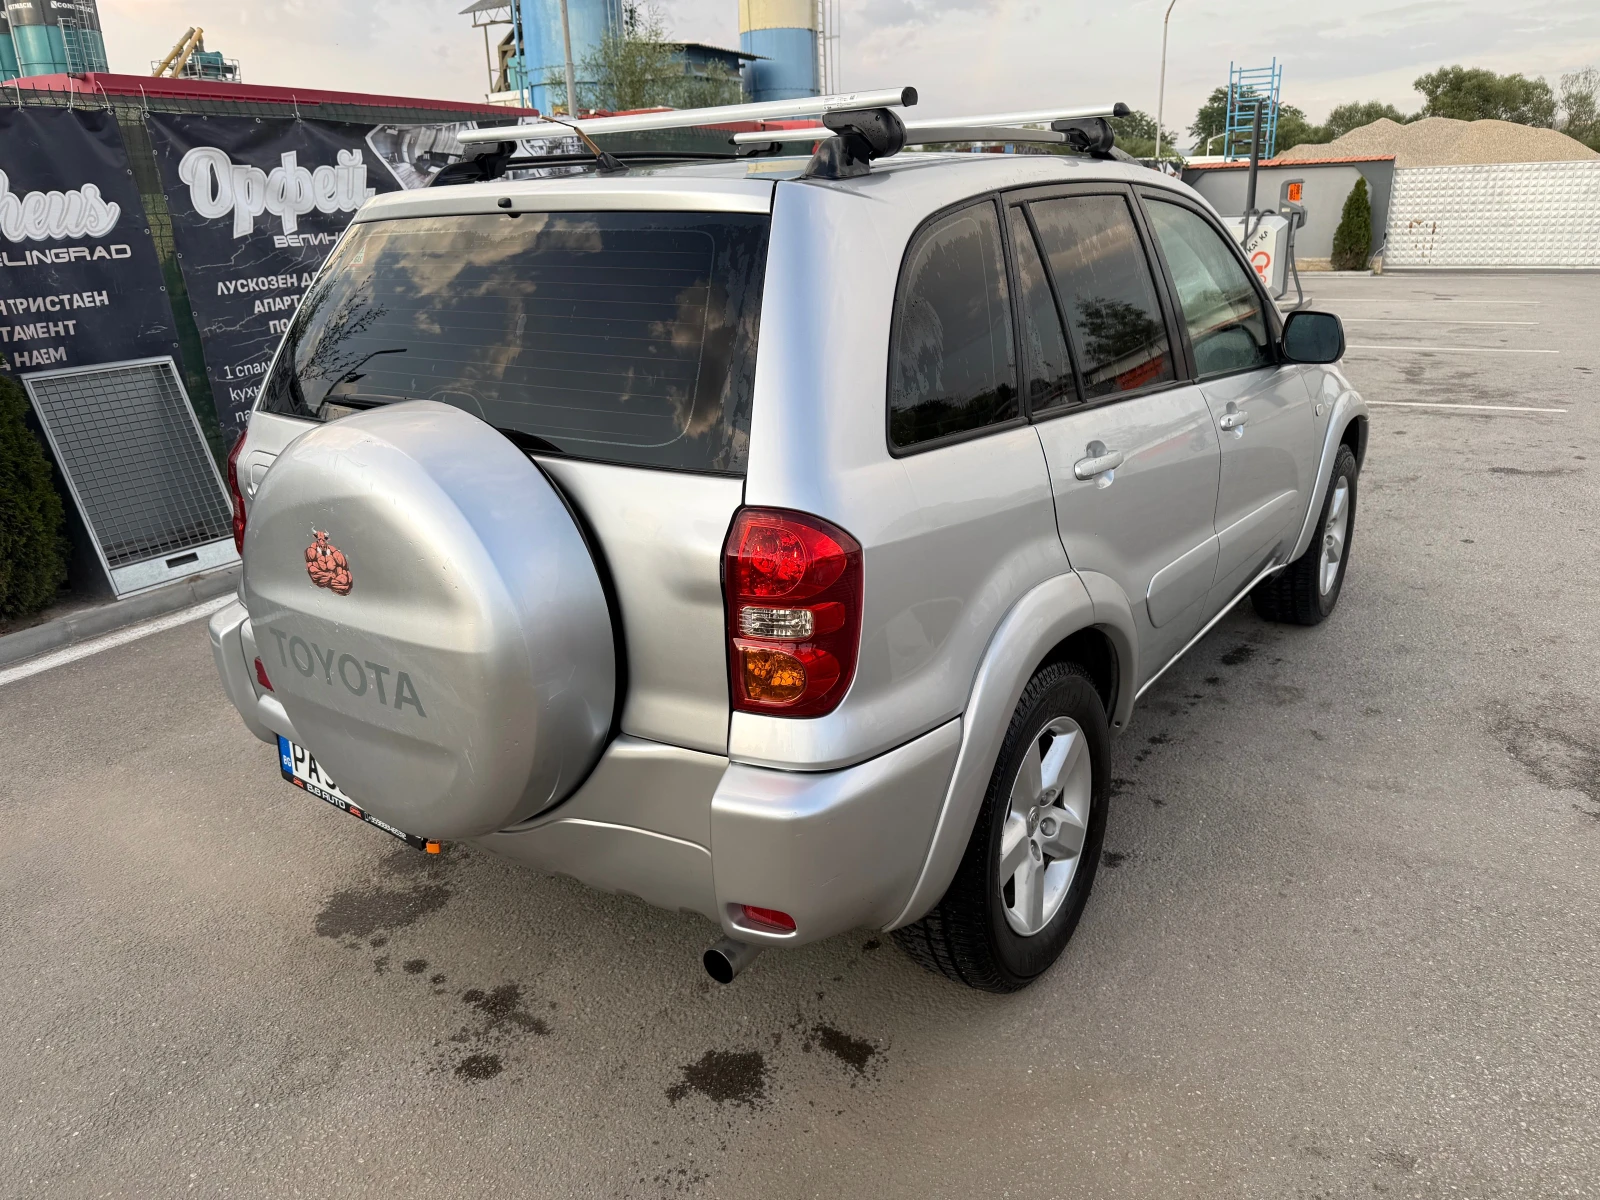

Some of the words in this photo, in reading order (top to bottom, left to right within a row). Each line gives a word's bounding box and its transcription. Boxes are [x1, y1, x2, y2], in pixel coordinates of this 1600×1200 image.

[178, 146, 376, 239] Орфей
[273, 231, 342, 248] ВЕЛИН
[0, 244, 132, 267] LINGRAD
[217, 274, 298, 296] ЛУСКОЗЕН
[7, 290, 110, 315] ТРИСТАЕН
[254, 294, 304, 314] АПАРТ
[0, 320, 76, 343] ТАМЕНТ
[13, 346, 68, 368] НАЕМ
[224, 365, 234, 379] 1
[236, 361, 271, 377] спал
[269, 626, 427, 719] TOYOTA
[322, 791, 346, 809] AUTO
